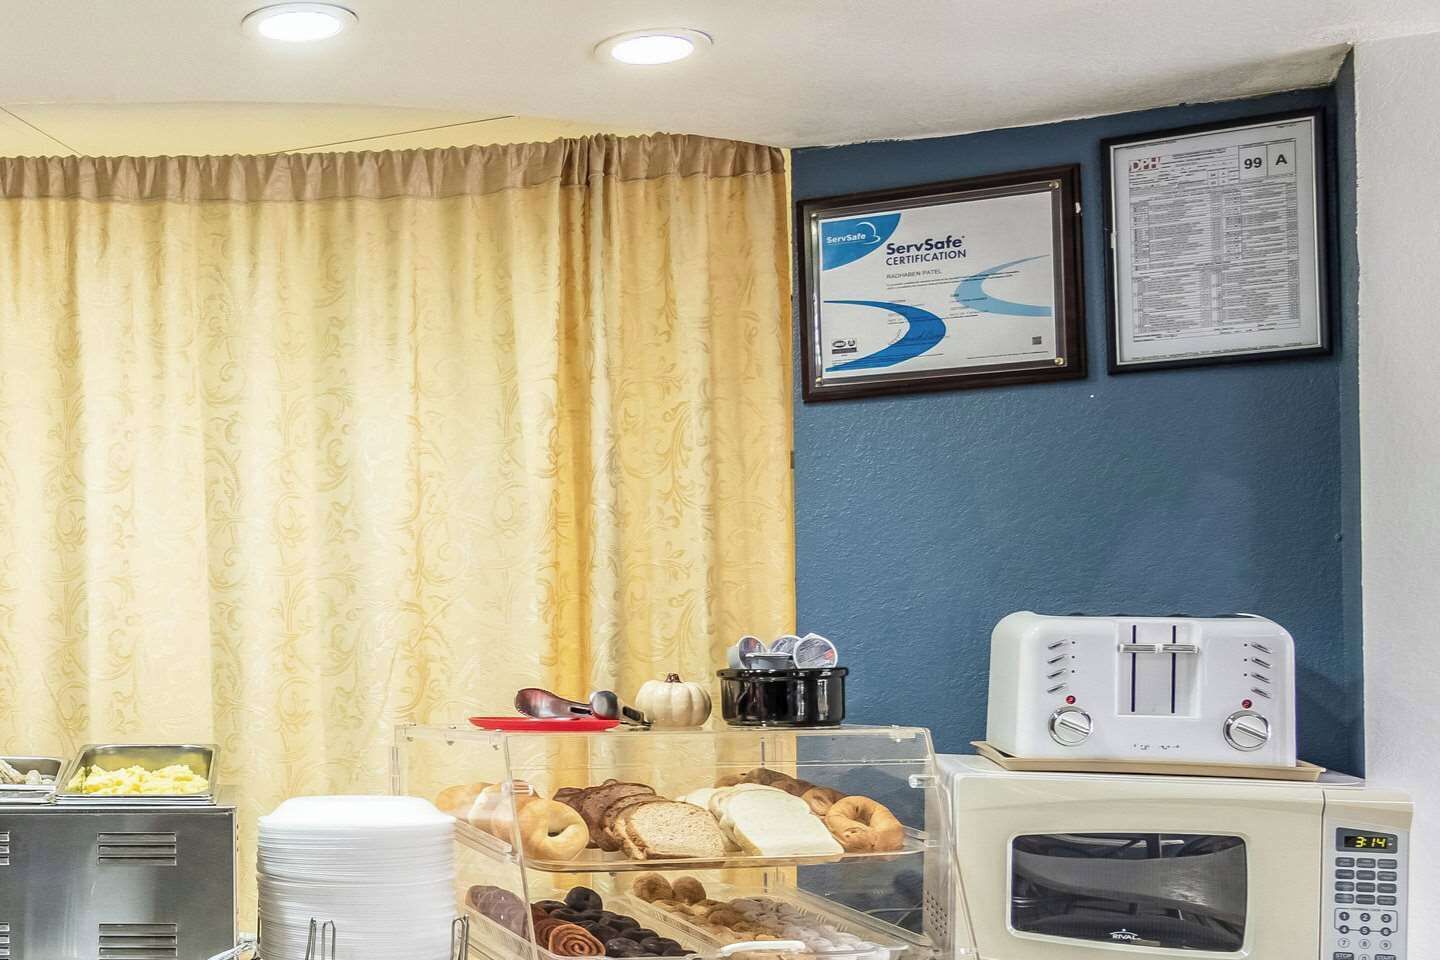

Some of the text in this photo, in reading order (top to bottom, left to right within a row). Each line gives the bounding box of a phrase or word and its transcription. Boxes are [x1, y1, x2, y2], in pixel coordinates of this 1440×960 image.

[1130, 156, 1161, 172] DPH
[1243, 154, 1288, 170] 99 A
[826, 232, 867, 244] ServSafe
[885, 235, 963, 255] ServSafe
[885, 249, 967, 266] CERTIFICATION
[1355, 836, 1386, 848] 3:14
